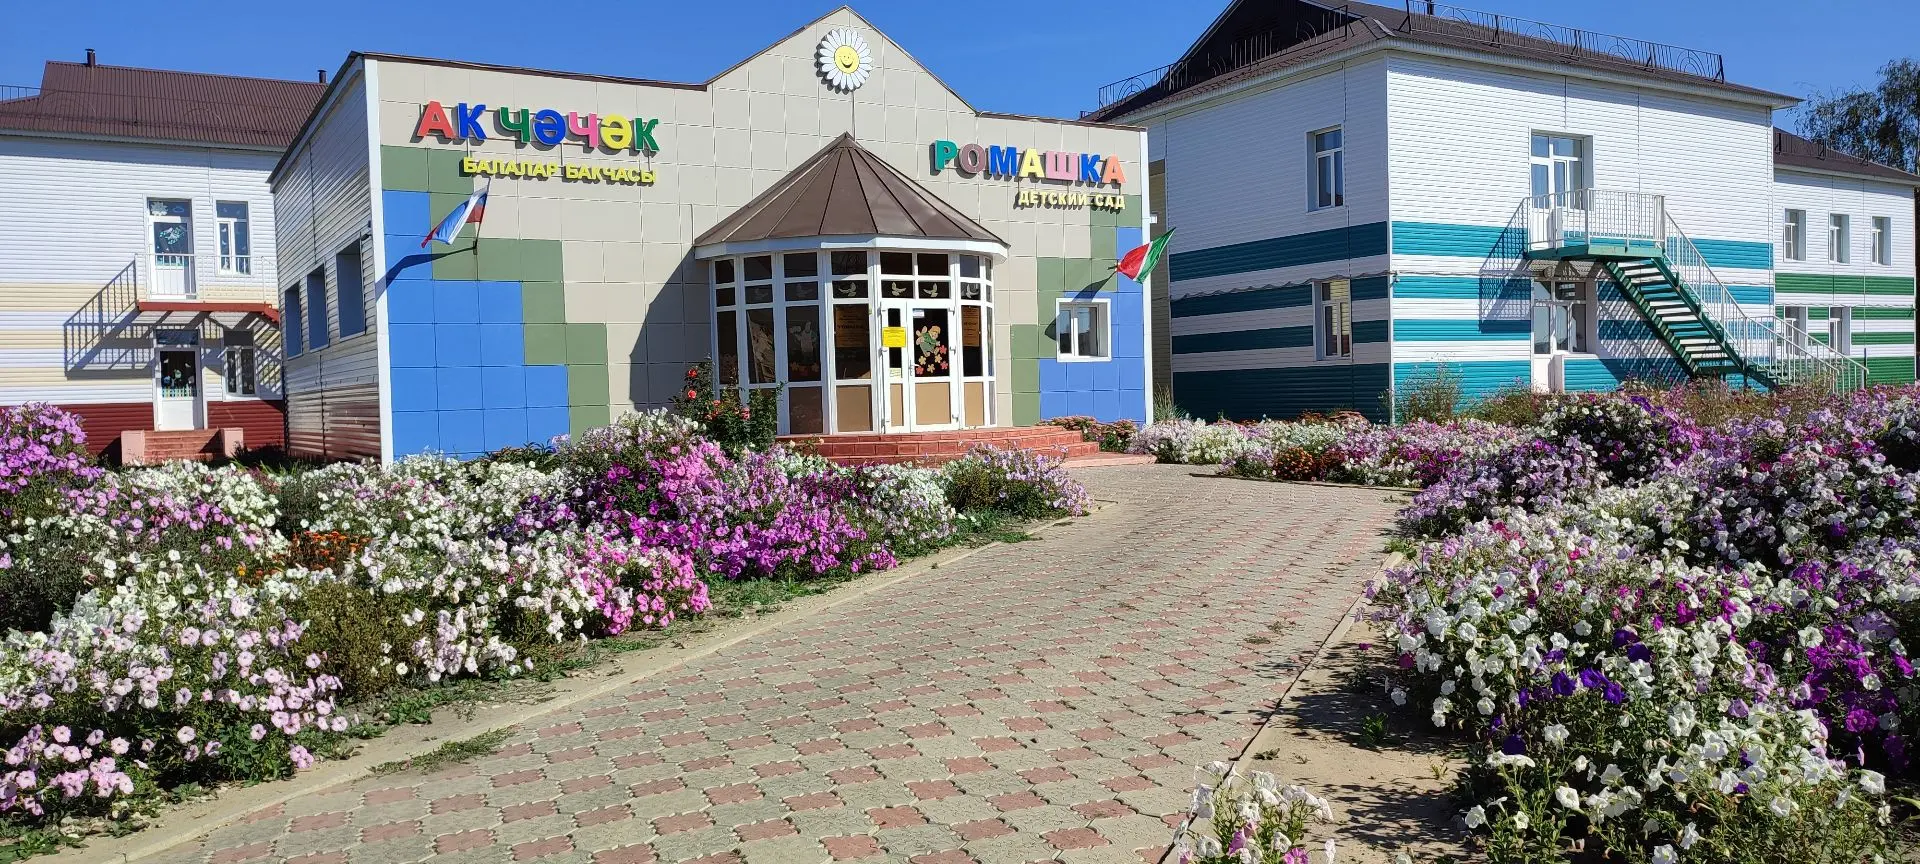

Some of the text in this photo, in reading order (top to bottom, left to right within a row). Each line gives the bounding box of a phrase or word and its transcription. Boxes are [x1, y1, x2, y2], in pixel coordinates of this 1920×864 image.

[417, 101, 660, 151] АК ЧӘЧӘК
[463, 157, 657, 184] БАЛАЛАР БАКЧАСЫ
[935, 139, 1126, 183] РОМАШКА
[1095, 194, 1126, 209] САД
